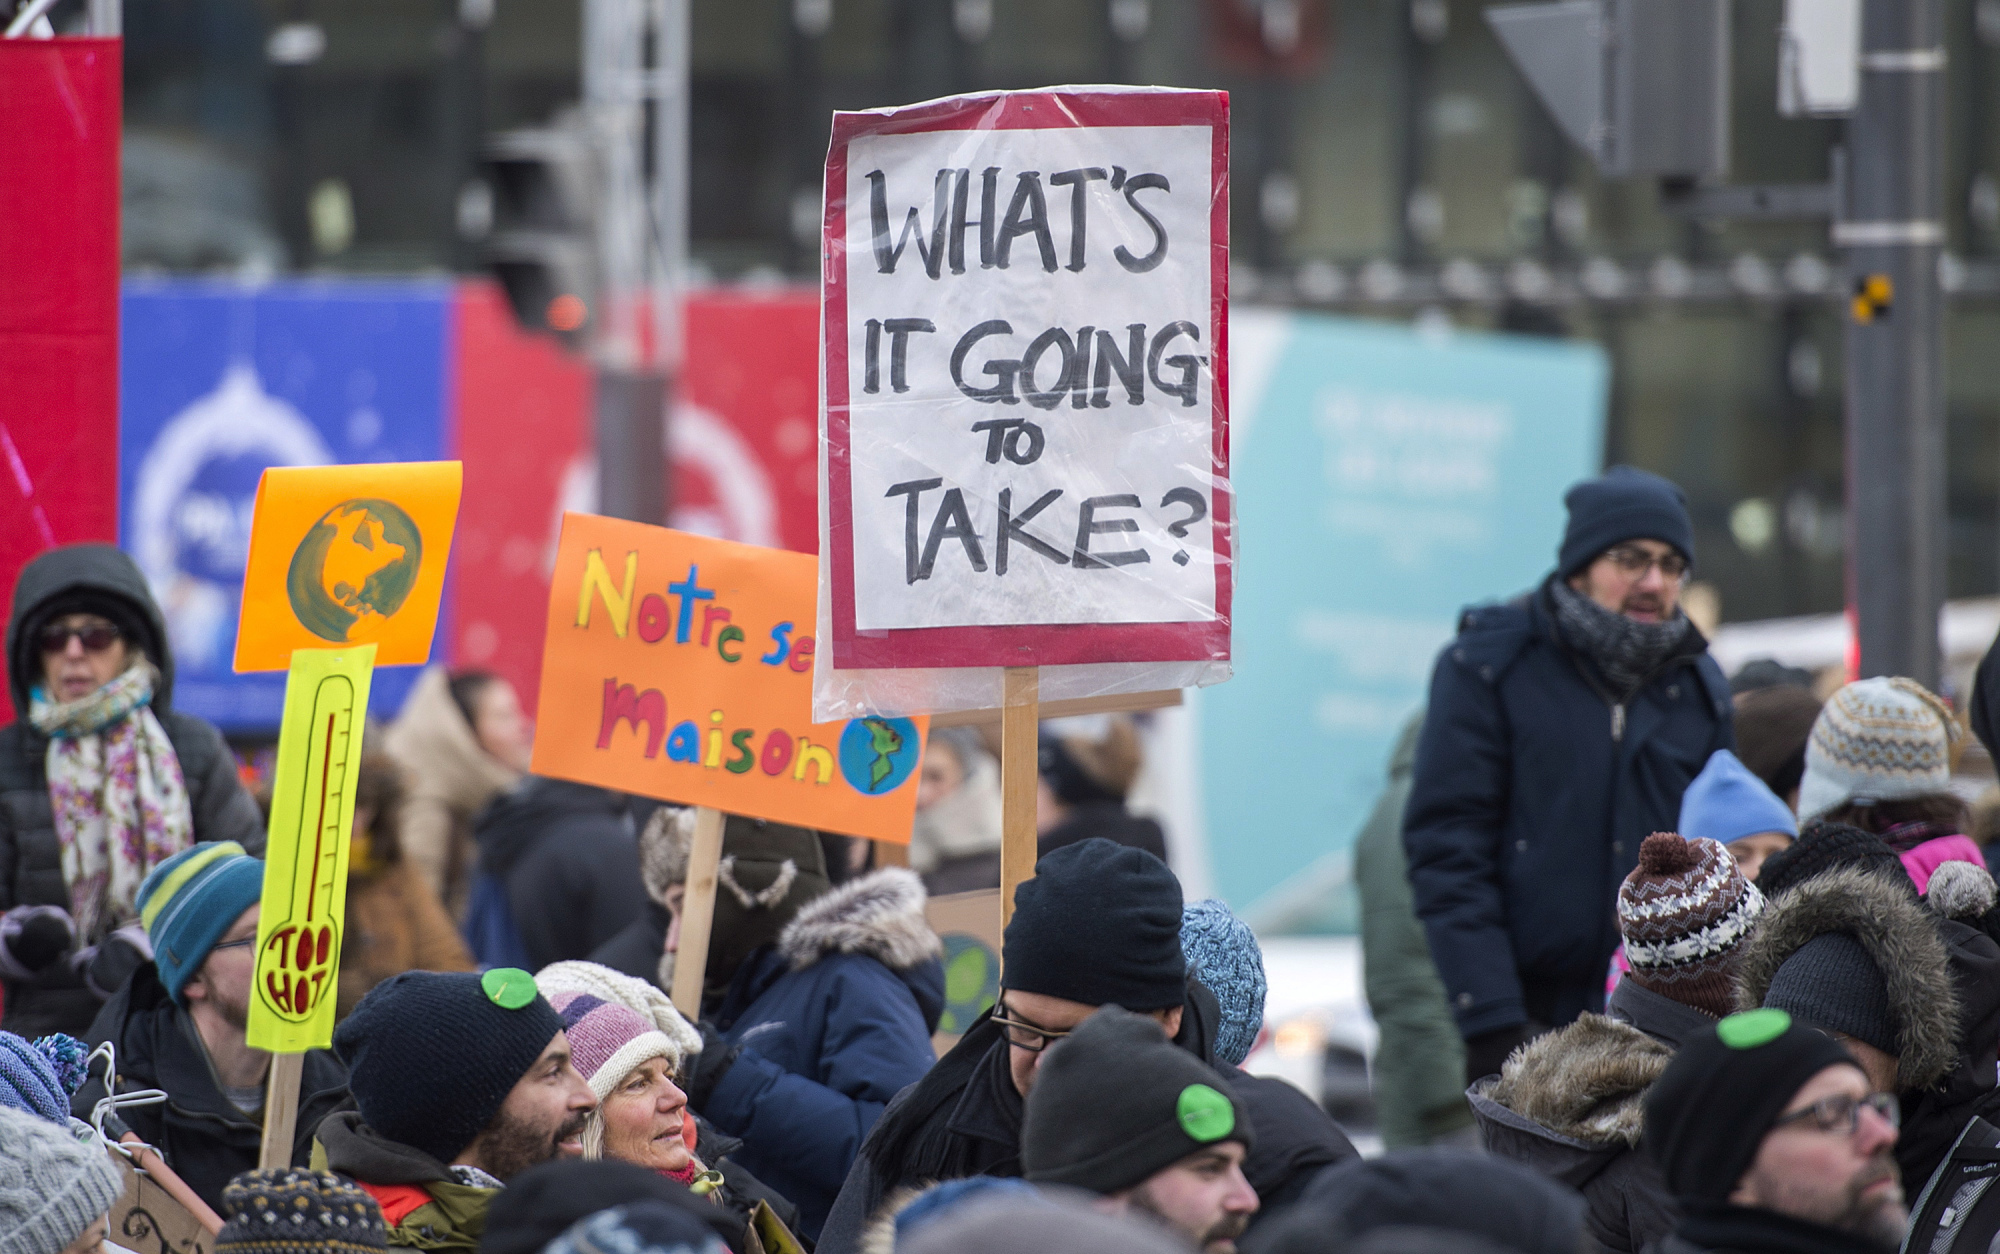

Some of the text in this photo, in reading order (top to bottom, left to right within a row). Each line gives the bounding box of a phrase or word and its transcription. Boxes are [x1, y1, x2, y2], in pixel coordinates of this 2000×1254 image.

[865, 165, 1170, 280] WHAT'S
[863, 318, 1208, 411] IT GOING
[971, 418, 1045, 465] TO
[884, 477, 1207, 585] TAKE?
[574, 547, 745, 662] Notre
[267, 969, 327, 1014] HOT
[268, 926, 331, 971] TOO
